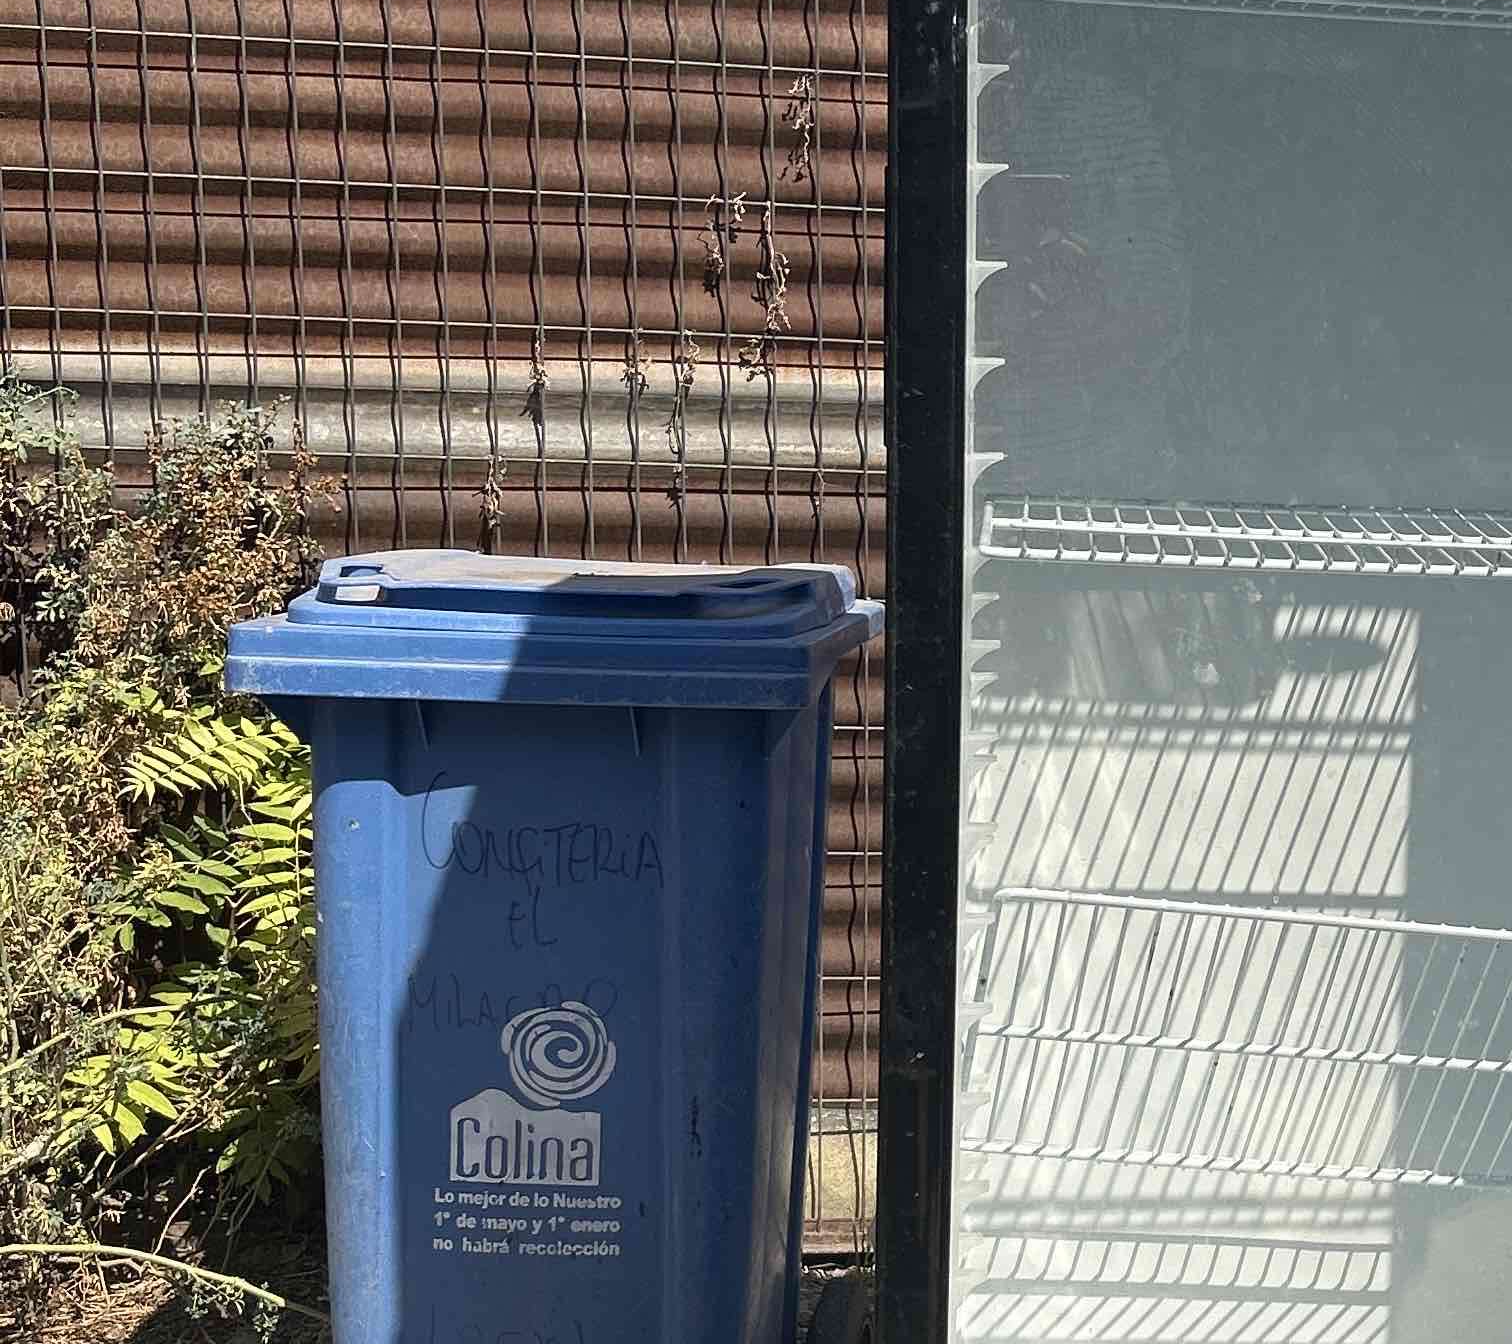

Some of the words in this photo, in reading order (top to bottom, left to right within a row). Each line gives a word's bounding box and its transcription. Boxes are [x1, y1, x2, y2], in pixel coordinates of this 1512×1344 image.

[456, 1117, 594, 1181] Colina
[434, 1187, 454, 1204] Lo
[458, 1190, 506, 1209] mejor
[508, 1191, 530, 1207] de
[533, 1192, 549, 1208] lo
[552, 1193, 622, 1209] Nuestro
[456, 1214, 477, 1230] de
[482, 1216, 527, 1233] mayo
[531, 1218, 543, 1235] y
[570, 1219, 622, 1233] enero
[433, 1237, 453, 1251] no
[462, 1237, 510, 1254] habrá
[519, 1239, 621, 1256] recolección
